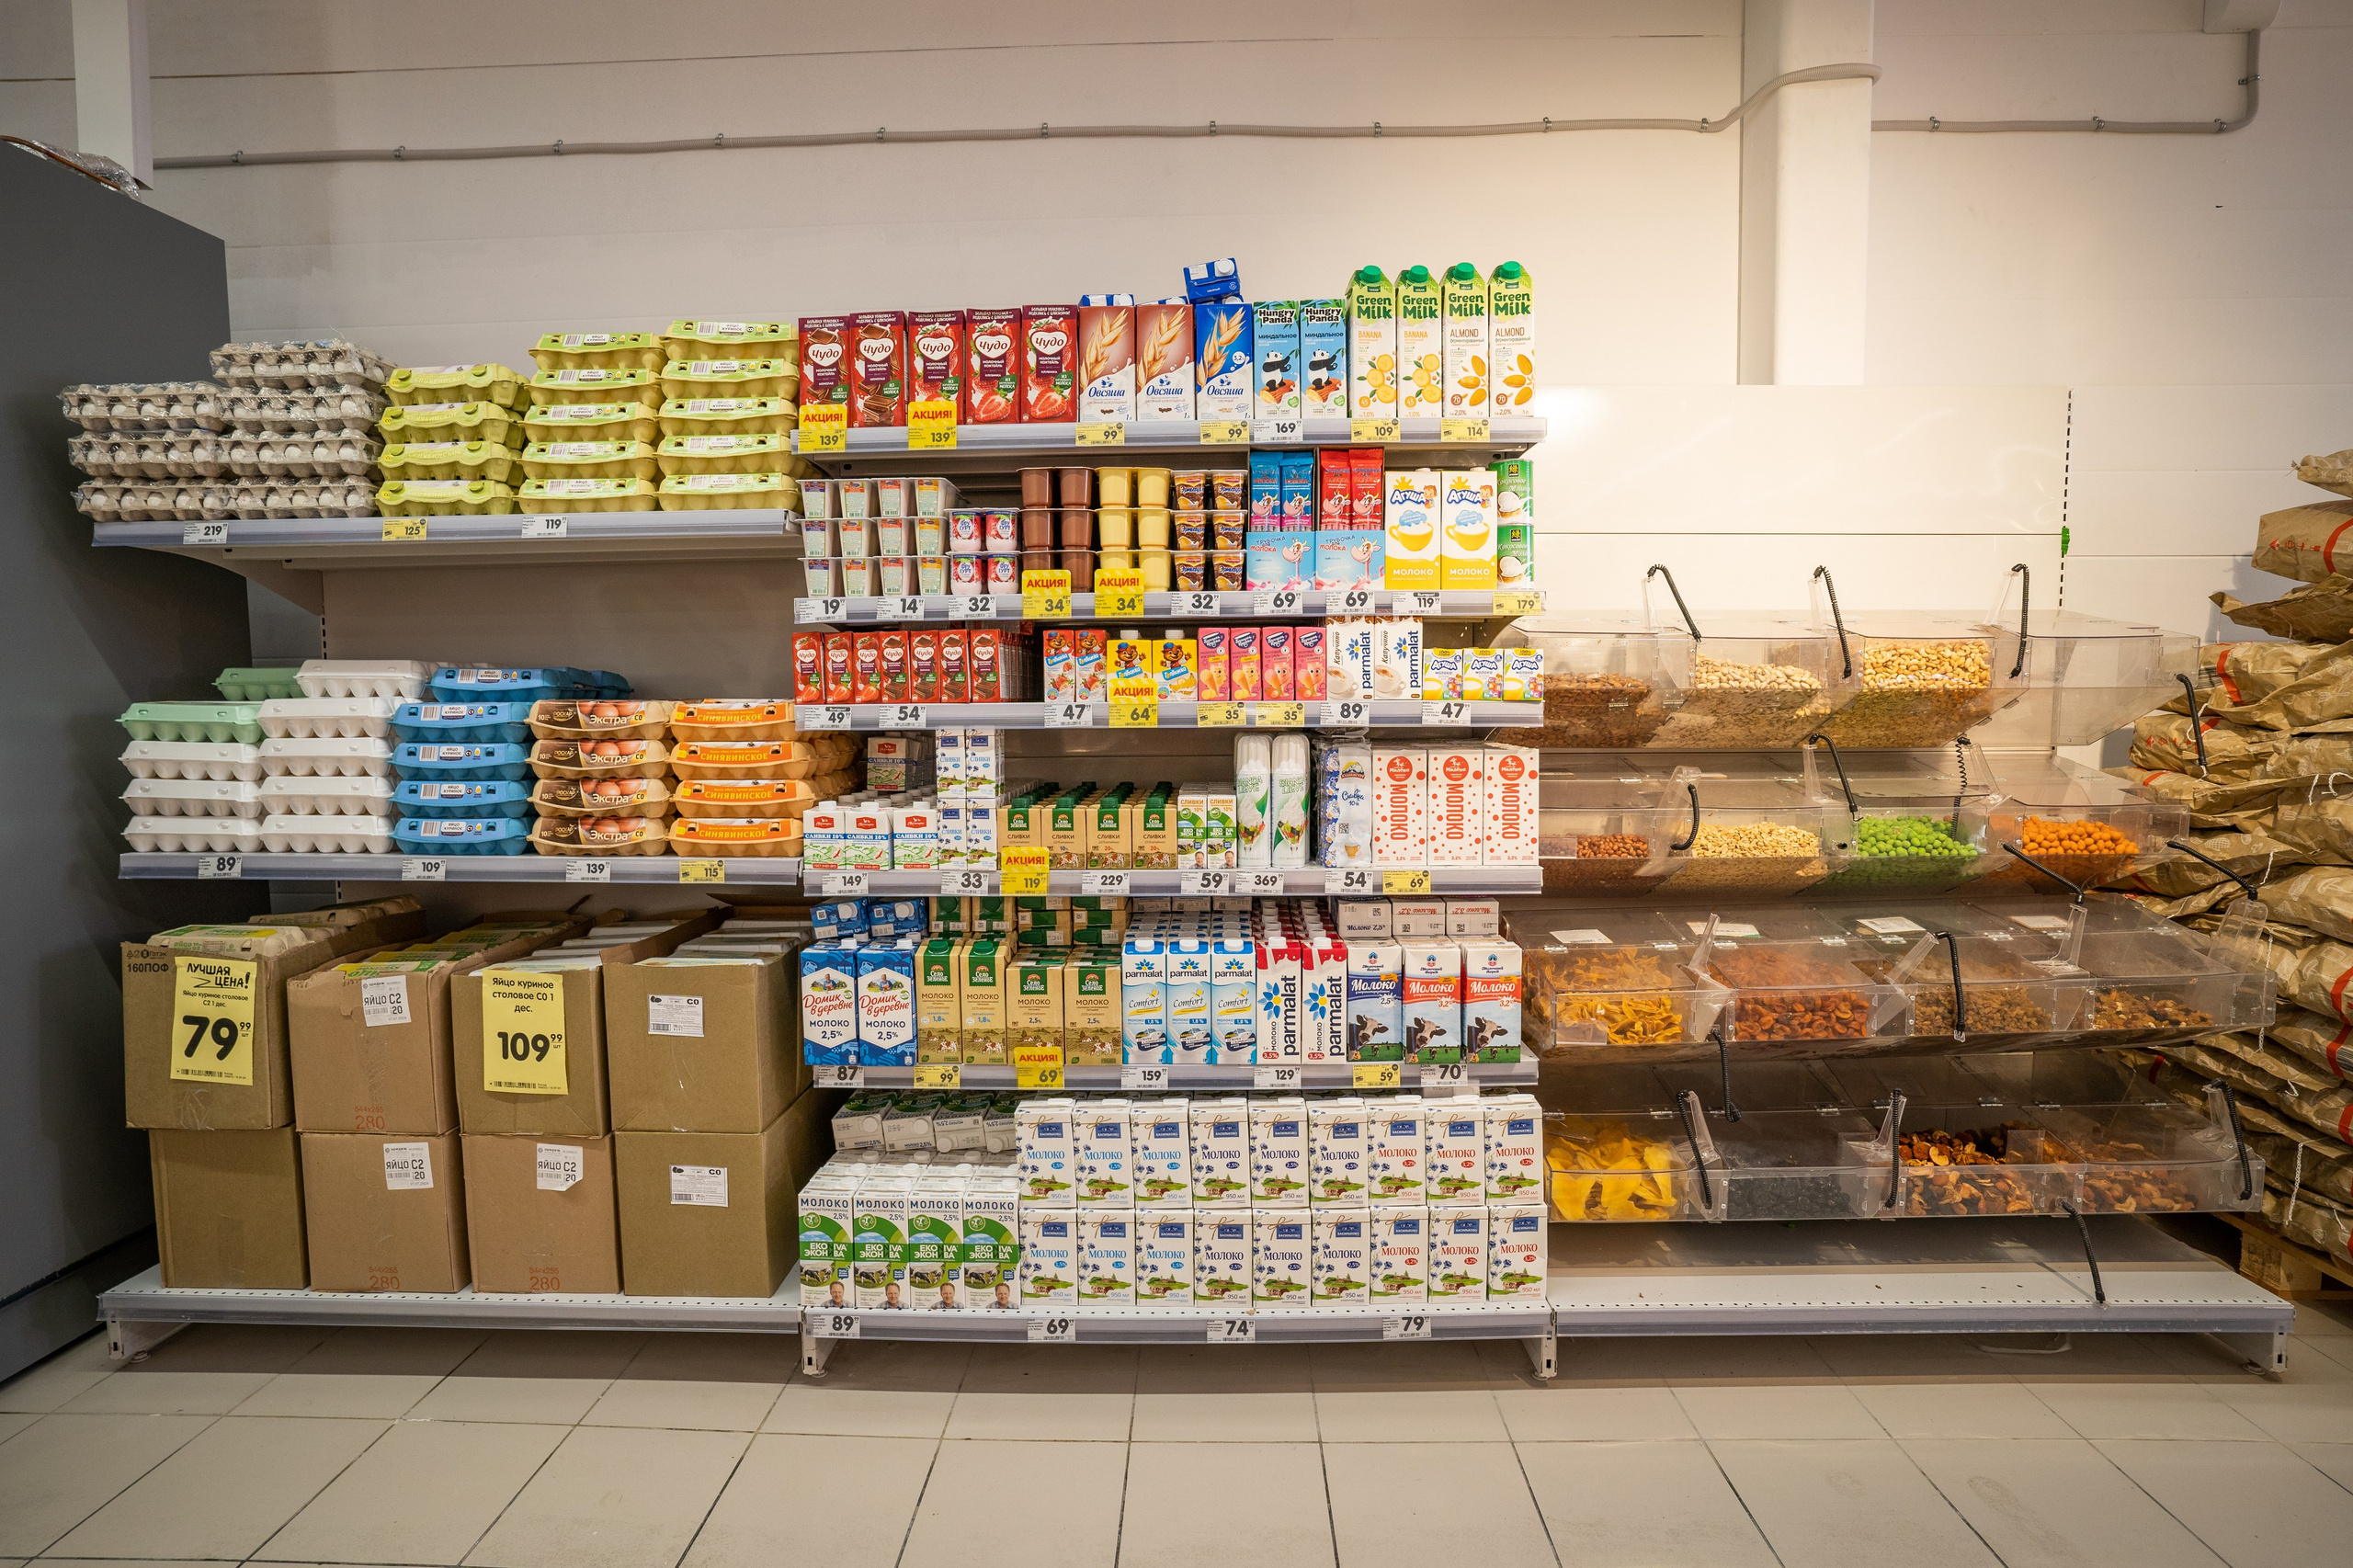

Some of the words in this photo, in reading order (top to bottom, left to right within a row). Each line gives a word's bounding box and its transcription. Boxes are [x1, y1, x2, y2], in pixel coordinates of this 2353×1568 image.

[1356, 293, 1392, 307] Green
[1494, 290, 1530, 304] Green
[1304, 307, 1342, 317] Hungry
[1357, 304, 1392, 320] Milk
[1495, 301, 1531, 317] Milk
[1309, 313, 1339, 324] Panda
[1404, 331, 1428, 339] BANANA
[1495, 327, 1525, 336] ALMOND
[1035, 335, 1064, 348] Чудо
[1088, 387, 1126, 399] Овсяша
[1206, 385, 1244, 396] Овсяша
[803, 413, 844, 424] АКЦИЯ!
[912, 410, 953, 421] АКЦИЯ!
[1275, 422, 1296, 434] 169
[1374, 426, 1393, 437] 109
[1467, 426, 1483, 437] 114
[819, 435, 839, 446] 139
[931, 431, 950, 443] 139
[545, 519, 562, 530] 119
[204, 526, 222, 536] 219
[404, 526, 420, 536] 125
[1256, 537, 1286, 545] ТРУБОЧКА
[1392, 567, 1435, 576] МОЛОКО
[1026, 579, 1067, 589] АКЦИЯ!
[823, 599, 839, 614] 19
[900, 597, 917, 613] 14
[968, 597, 989, 611] 32
[1044, 599, 1063, 612] 34
[1116, 597, 1135, 610] 34
[1192, 594, 1213, 609] 32
[1273, 593, 1295, 608] 69
[1345, 593, 1367, 608] 69
[1416, 597, 1435, 608] 119
[1517, 599, 1535, 609] 179
[1381, 631, 1390, 664] Капучино
[976, 651, 993, 660] Чудо
[1409, 631, 1420, 688] parmalat
[1113, 687, 1154, 697] АКЦИЯ!
[898, 707, 920, 721] 54
[1063, 705, 1086, 720] 47
[1131, 708, 1150, 721] 64
[1225, 710, 1239, 720] 35
[1284, 710, 1298, 721] 35
[1340, 702, 1363, 718] 89
[1440, 702, 1464, 717] 47
[589, 713, 628, 727] Экстра
[827, 711, 846, 724] 49
[700, 752, 768, 762] СИНЯВИНСКОЕ
[1446, 783, 1464, 840] МОЛОКО
[589, 829, 628, 842] Экстра
[699, 829, 767, 838] СИНЯВИНСКОЕ
[216, 857, 236, 871] 89
[1006, 855, 1045, 866] АКЦИЯ!
[421, 862, 440, 873] 109
[586, 862, 606, 874] 139
[704, 868, 720, 878] 115
[842, 875, 862, 886] 149
[961, 873, 983, 889] 33
[1024, 877, 1040, 889] 119
[1101, 874, 1123, 886] 229
[1200, 872, 1222, 888] 59
[1254, 875, 1277, 887] 369
[1344, 872, 1367, 887] 54
[1410, 878, 1424, 888] 69
[1372, 923, 1386, 932] 2,5%
[127, 962, 169, 972] 160ПОФ
[187, 962, 231, 975] ЛУЧШАЯ
[214, 971, 250, 988] ЦЕНА!
[1125, 970, 1164, 980] parmalat
[1214, 969, 1253, 979] parmalat
[492, 978, 515, 988] Яйцо
[517, 981, 554, 991] куриное
[1351, 979, 1396, 992] Молоко
[1410, 982, 1455, 994] Молоко
[182, 990, 198, 998] Яйцо
[199, 992, 219, 1001] куриное
[364, 995, 387, 1006] ЯЙЦО
[389, 993, 402, 1005] С2
[492, 990, 534, 1001] столовое
[802, 994, 841, 1009] Домик
[1218, 996, 1249, 1007] Comfort
[1380, 997, 1394, 1006] 2,5%
[392, 1006, 403, 1015] 20
[514, 1004, 533, 1014] дес.
[816, 1001, 854, 1017] деревне
[1327, 976, 1345, 1056] parmalat
[182, 1016, 239, 1061] 79
[239, 1022, 251, 1030] 99
[877, 1030, 899, 1040] 2,5%
[497, 1031, 550, 1062] 109
[551, 1034, 563, 1042] 99
[1019, 1053, 1059, 1064] АКЦИЯ!
[836, 1066, 858, 1081] 87
[1039, 1070, 1058, 1082] 69
[1142, 1070, 1161, 1081] 159
[1275, 1069, 1294, 1080] 129
[1380, 1072, 1393, 1082] 59
[1438, 1064, 1461, 1080] 70
[356, 1115, 385, 1130] 280
[1201, 1149, 1241, 1160] МОЛОКО
[386, 1160, 409, 1171] ЯЙЦО
[411, 1159, 425, 1170] С2
[538, 1160, 561, 1171] ЯЙЦО
[563, 1161, 577, 1173] С2
[414, 1171, 426, 1180] 20
[565, 1173, 577, 1183] 20
[801, 1199, 848, 1209] МОЛОКО
[1440, 1245, 1479, 1256] МОЛОКО
[529, 1276, 561, 1291] 280
[832, 1315, 854, 1332] 89
[1046, 1319, 1069, 1335] 69
[1225, 1320, 1248, 1336] 74
[1402, 1316, 1424, 1332] 79
